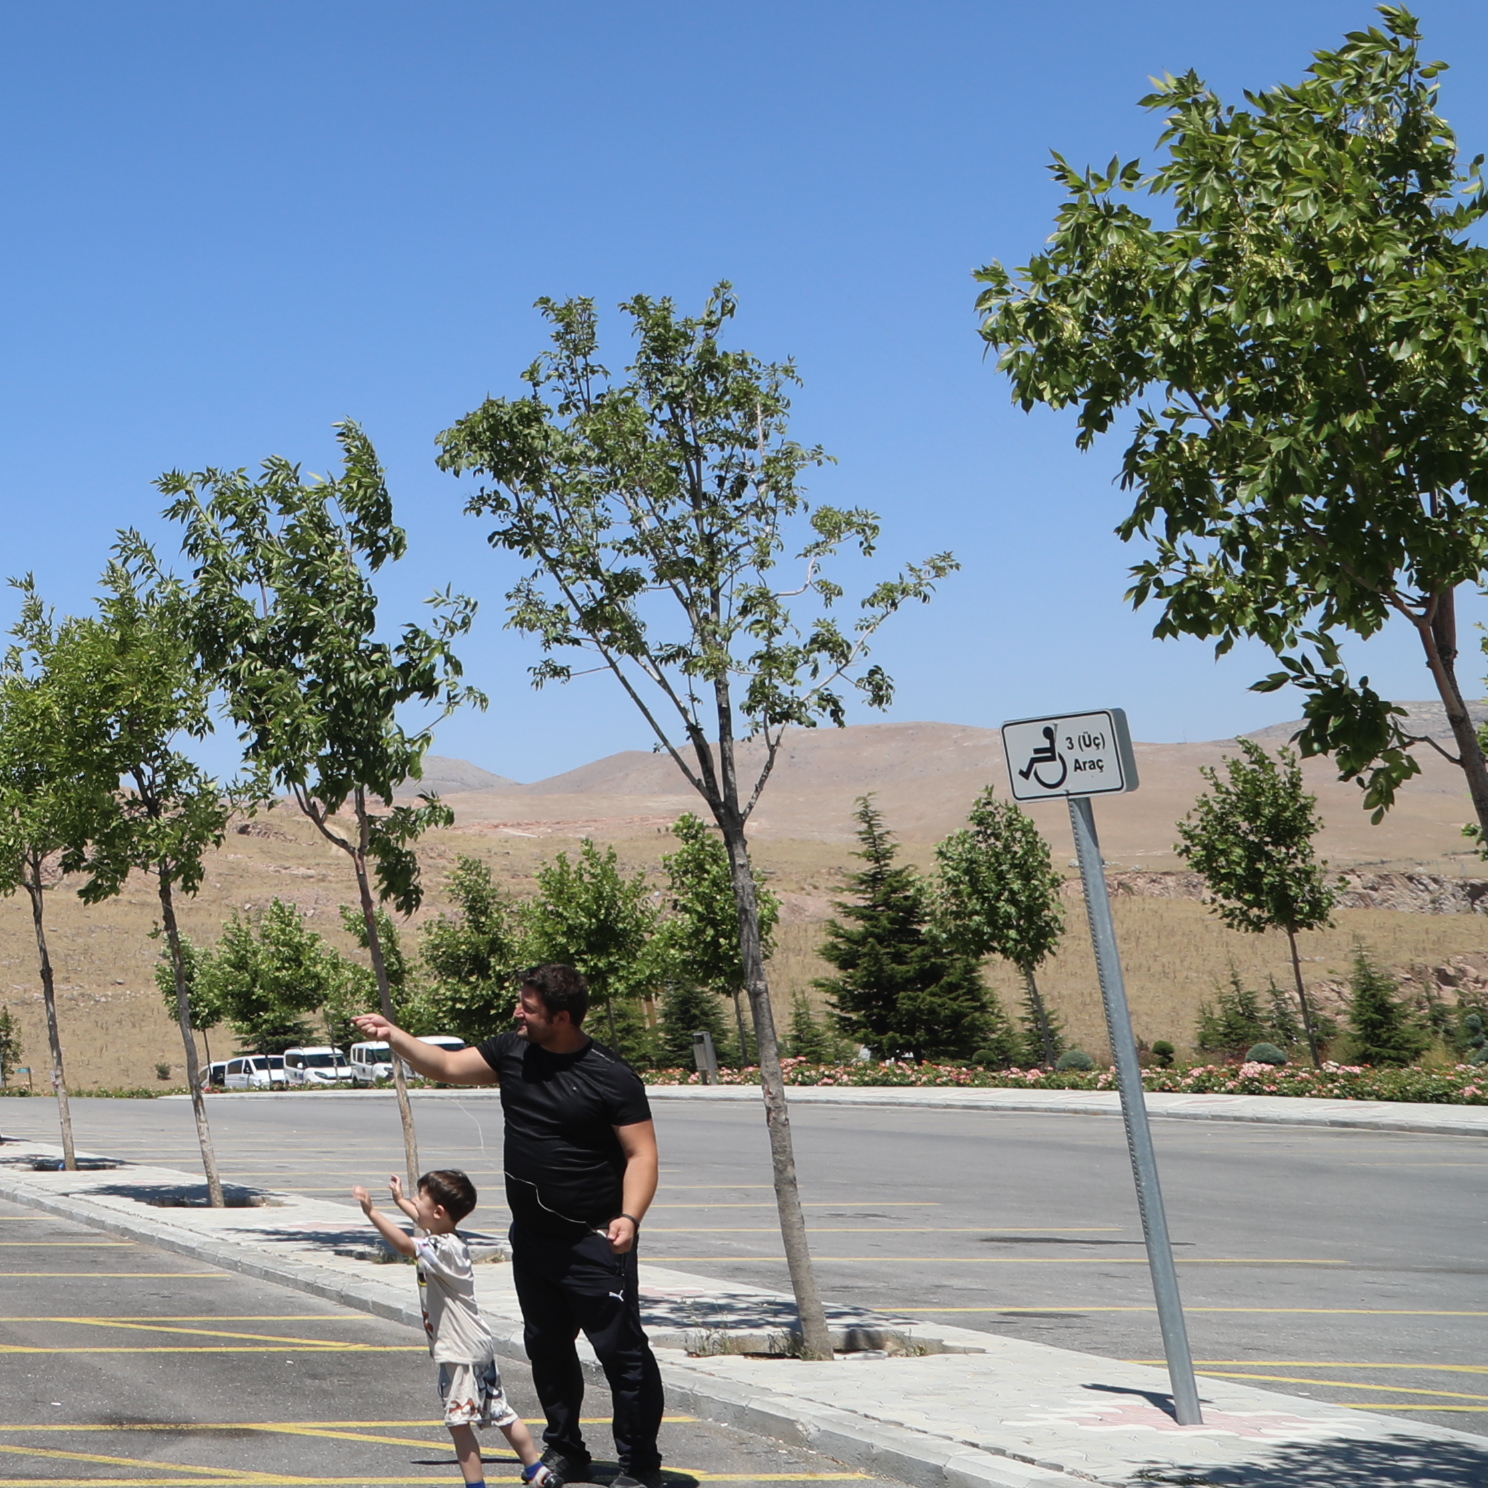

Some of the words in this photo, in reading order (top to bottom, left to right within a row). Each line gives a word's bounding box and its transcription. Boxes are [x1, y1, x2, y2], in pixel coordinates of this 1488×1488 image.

[1065, 736, 1074, 750] 3
[1078, 731, 1105, 752] (Üç)
[1073, 758, 1104, 773] Araç
